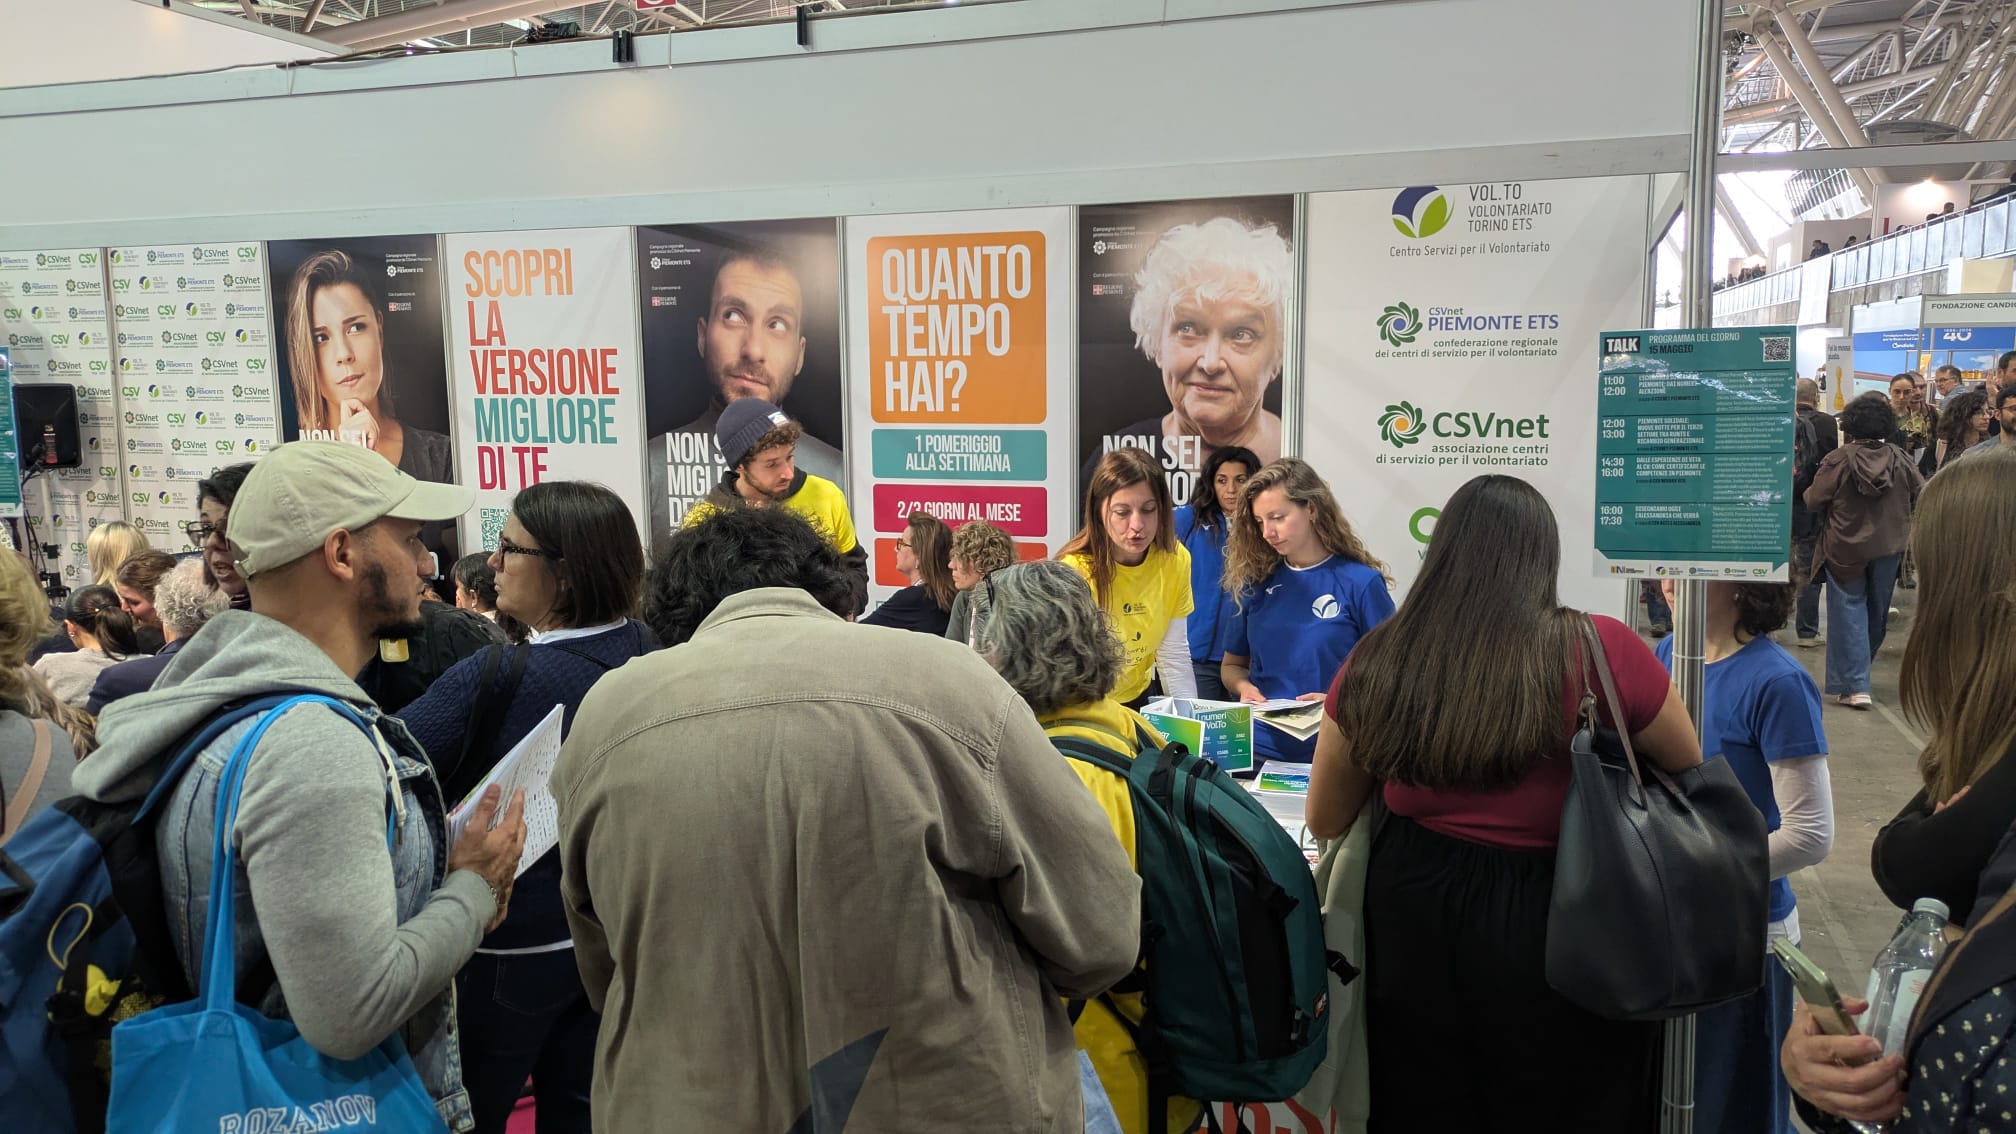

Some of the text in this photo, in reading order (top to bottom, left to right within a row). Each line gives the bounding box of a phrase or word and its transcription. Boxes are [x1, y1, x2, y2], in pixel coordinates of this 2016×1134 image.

[1470, 184, 1521, 201] VOL.TO
[1468, 202, 1552, 218] VOLONTARIATO
[1468, 218, 1532, 232] TORINO ETS
[237, 247, 257, 257] CSV
[1390, 241, 1550, 257] Centro Servizi per il Volontariato
[79, 254, 97, 264] CSV
[464, 248, 573, 298] SCOPRI
[882, 244, 1031, 306] QUANTO
[112, 279, 130, 289] CSV
[4, 309, 22, 319] CSV
[126, 306, 149, 314] CSVnet
[158, 305, 176, 315] CSV
[1429, 307, 1464, 316] CSVnet
[468, 300, 506, 346] LA
[1428, 315, 1559, 331] PIEMONTE ETS
[882, 302, 1010, 358] TEMPO
[51, 334, 69, 344] CSV
[173, 333, 197, 341] CSVnet
[206, 332, 226, 342] CSV
[1649, 332, 1740, 344] PROGRAMMA DEL GIORNO
[1434, 338, 1558, 348] confederazione regionale
[1606, 338, 1638, 352] TALK
[1375, 348, 1557, 359] dei centri di servizio per il volontariato
[1649, 344, 1694, 354] 15 MAGGIO
[88, 360, 107, 370] CSV
[212, 360, 238, 368] CSVnet
[246, 359, 266, 369] CSV
[470, 348, 620, 396] VERSIONE
[1604, 376, 1624, 385] 11:00
[884, 360, 968, 412] HAI?
[1603, 386, 1626, 396] 12:00
[122, 387, 139, 397] CSV
[244, 388, 269, 396] CSVnet
[136, 414, 158, 422] CSVnet
[167, 413, 186, 423] CSV
[474, 398, 618, 444] MIGLIORE
[1432, 412, 1549, 438] CSVnet
[1603, 419, 1625, 428] 12:00
[1602, 429, 1624, 438] 13:00
[183, 440, 206, 449] CSVnet
[216, 440, 235, 450] CSV
[666, 432, 709, 464] NON
[915, 435, 1000, 453] 1 POMERIGGIO
[1432, 444, 1548, 454] associazione centri
[1162, 435, 1200, 470] SEI
[906, 453, 1011, 472] ALLA SETTIMANA
[1376, 454, 1548, 466] di servizio per il volontariato
[1602, 458, 1624, 466] 14:30
[99, 467, 117, 476] CSV
[477, 446, 548, 490] DI TE
[1601, 468, 1624, 477] 16:00
[132, 493, 150, 502] CSV
[898, 501, 1021, 521] 2/3 GIORNI AL MESE
[1600, 506, 1623, 514] 16:00
[146, 520, 168, 528] CSVnet
[1600, 516, 1622, 525] 17:30
[1201, 712, 1226, 720] numeri
[1206, 721, 1227, 729] VolTo
[220, 1094, 376, 1134] ROZANOV
